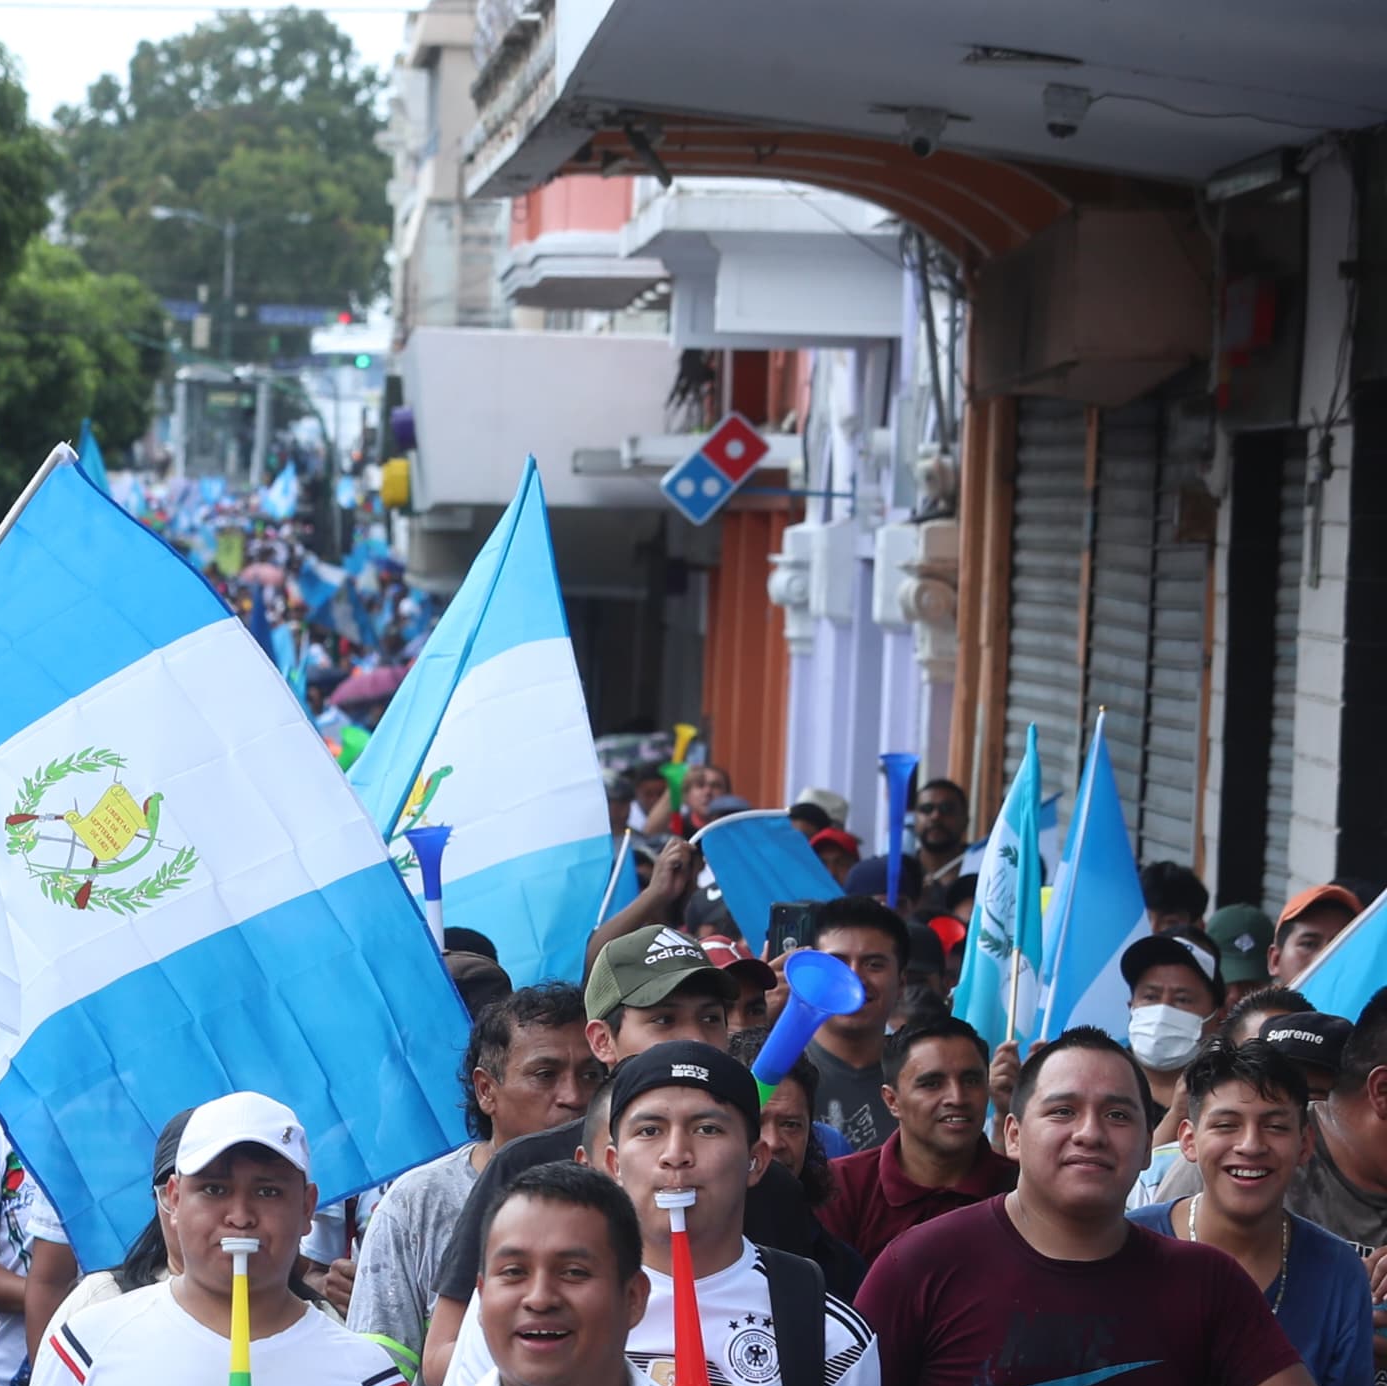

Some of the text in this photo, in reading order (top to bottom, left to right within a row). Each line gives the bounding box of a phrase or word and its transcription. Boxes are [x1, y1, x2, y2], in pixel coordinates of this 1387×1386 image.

[644, 946, 704, 965] adidas
[1266, 1029, 1324, 1045] Supreme
[671, 1063, 710, 1076] WHITE
[671, 1069, 710, 1082] BOX
